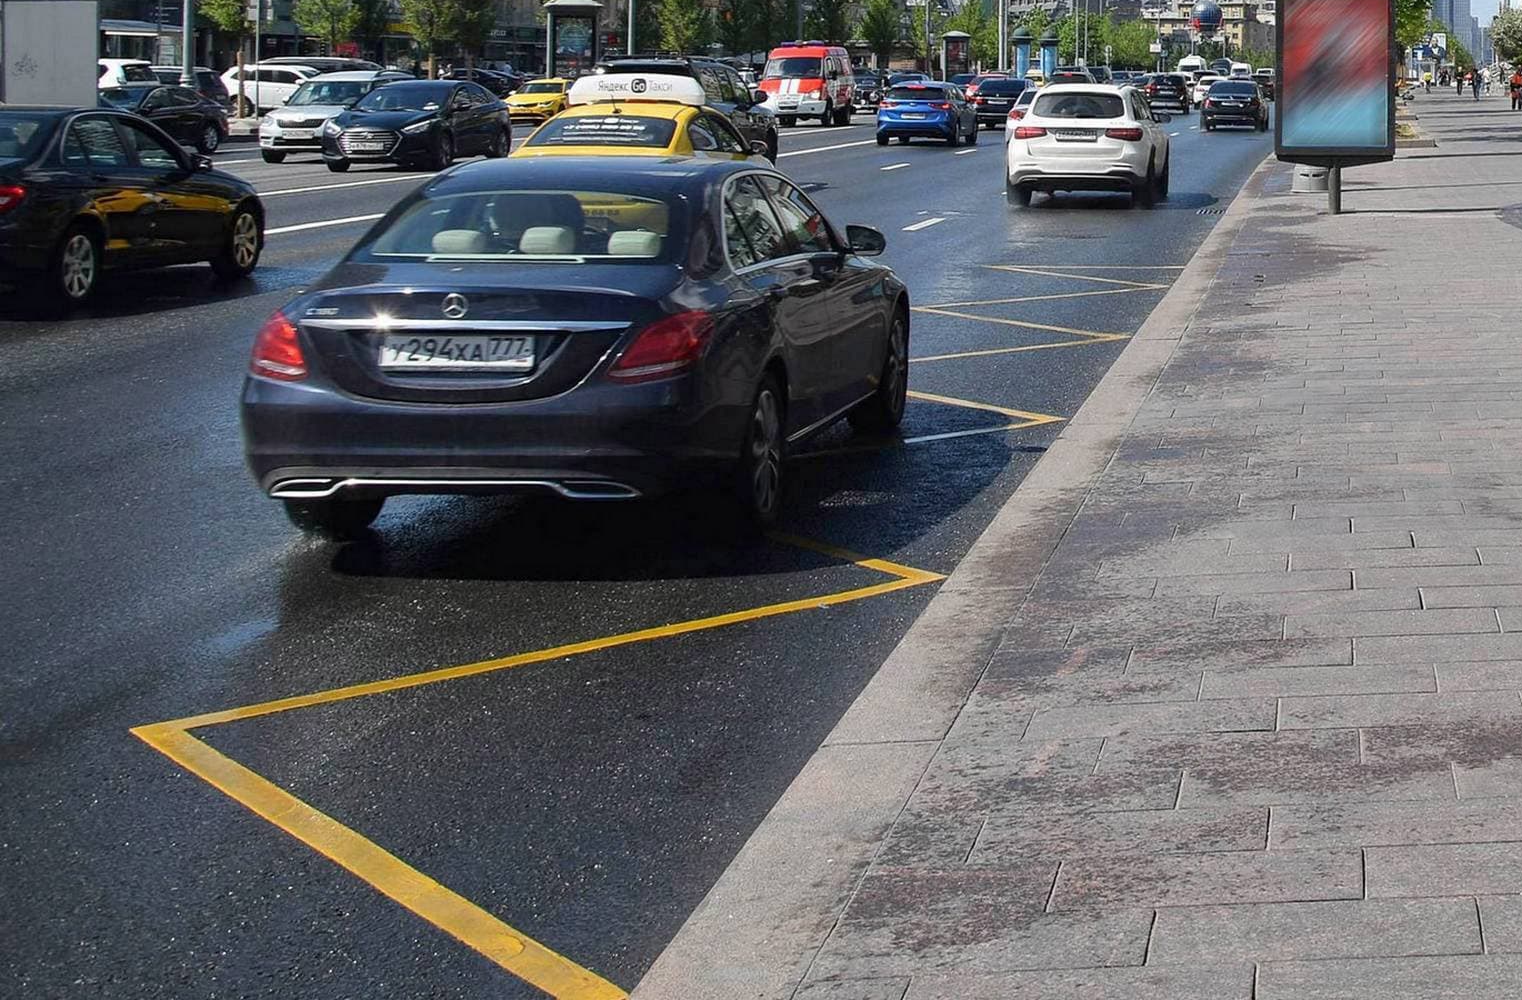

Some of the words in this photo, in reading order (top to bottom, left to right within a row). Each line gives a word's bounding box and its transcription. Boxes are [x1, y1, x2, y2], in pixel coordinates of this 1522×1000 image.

[598, 81, 629, 92] Яндекс
[632, 80, 646, 92] Go
[649, 81, 673, 92] Такси
